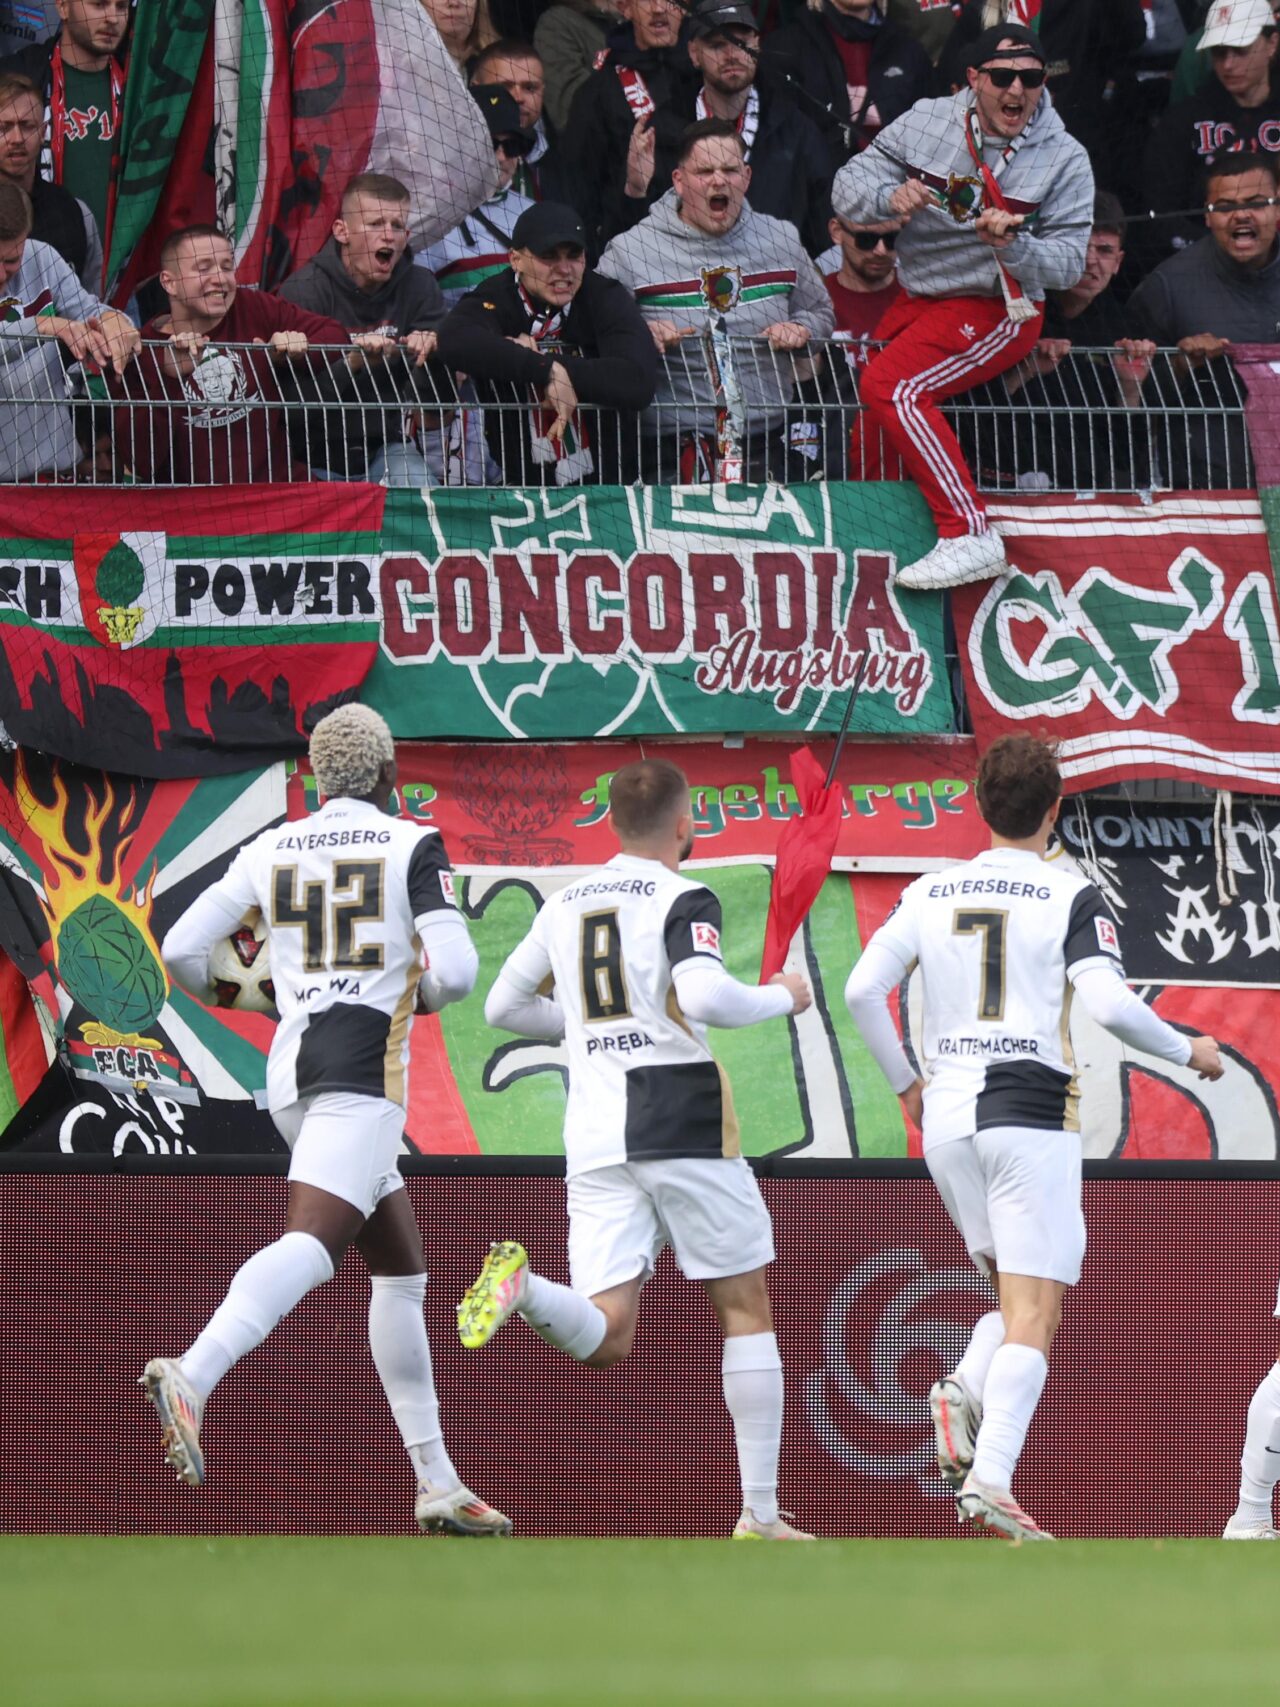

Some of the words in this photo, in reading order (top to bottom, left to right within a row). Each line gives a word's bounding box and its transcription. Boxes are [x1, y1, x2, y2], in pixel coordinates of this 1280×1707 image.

[175, 561, 375, 617] POWER
[379, 550, 912, 660] CONCORDIA
[695, 628, 930, 712] Augsburg
[276, 830, 391, 851] ELVERSBERG
[1061, 813, 1218, 850] CONNY
[271, 858, 386, 974] 42
[928, 879, 1051, 901] ELVERSBERG
[578, 906, 633, 1024] 8
[952, 908, 1010, 1022] 7
[94, 1048, 161, 1081] FCA
[938, 1037, 1040, 1056] KRATTEMACHER
